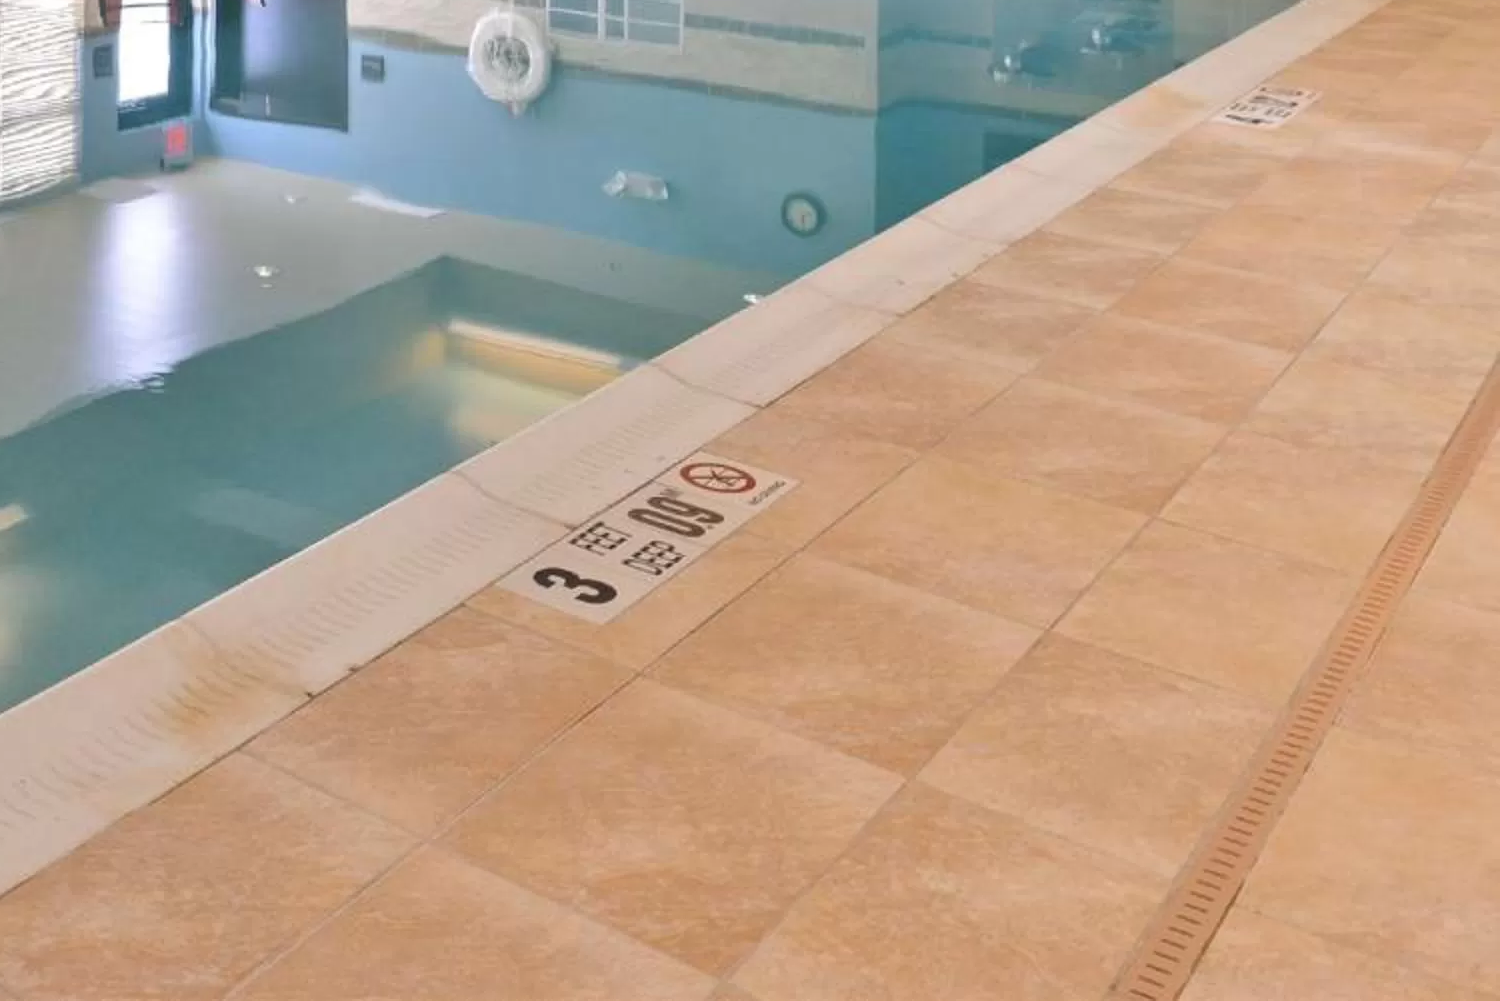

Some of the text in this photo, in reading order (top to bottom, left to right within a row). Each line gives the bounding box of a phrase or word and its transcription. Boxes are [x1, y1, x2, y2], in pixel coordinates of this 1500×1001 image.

[568, 520, 634, 556] FEET
[621, 539, 687, 577] DEEP
[532, 566, 618, 605] 3
